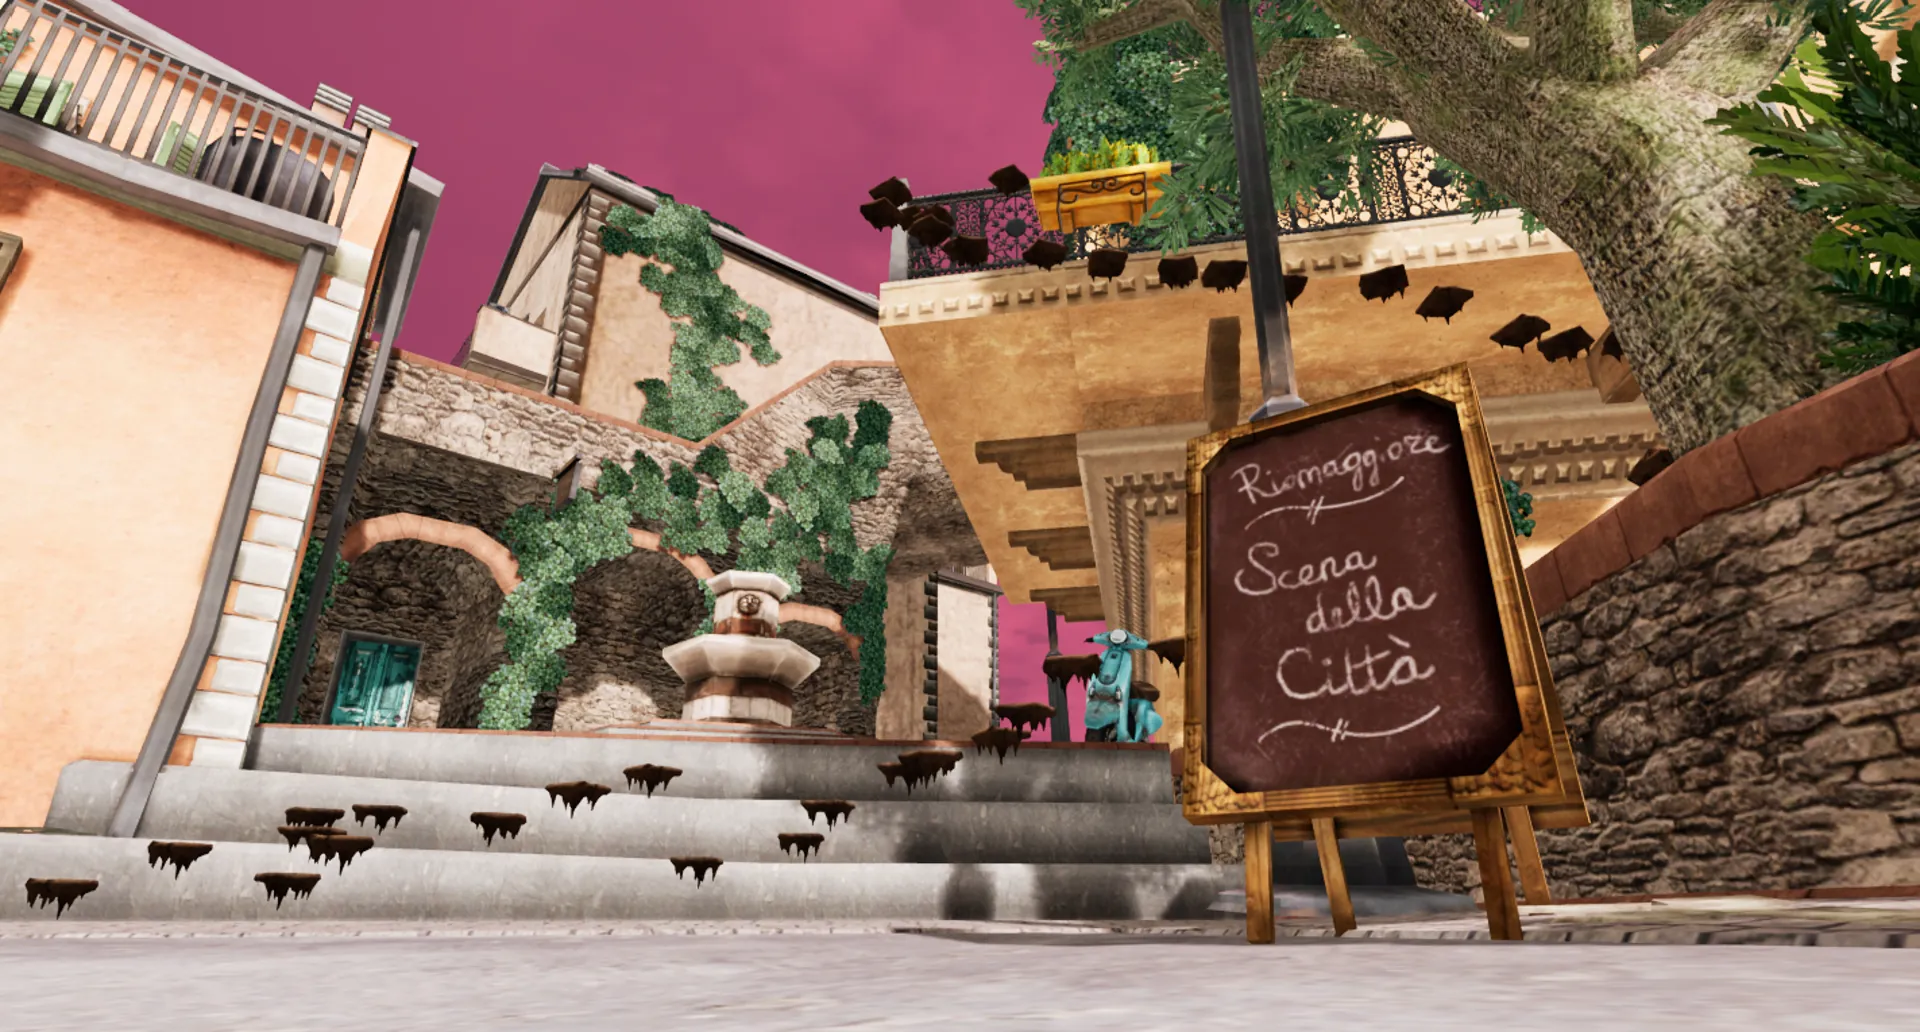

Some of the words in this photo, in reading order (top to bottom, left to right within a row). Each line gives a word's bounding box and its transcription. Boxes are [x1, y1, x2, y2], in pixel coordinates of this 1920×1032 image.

[1234, 542, 1377, 596] Scena
[1306, 576, 1437, 633] della
[1276, 634, 1436, 699] Città
